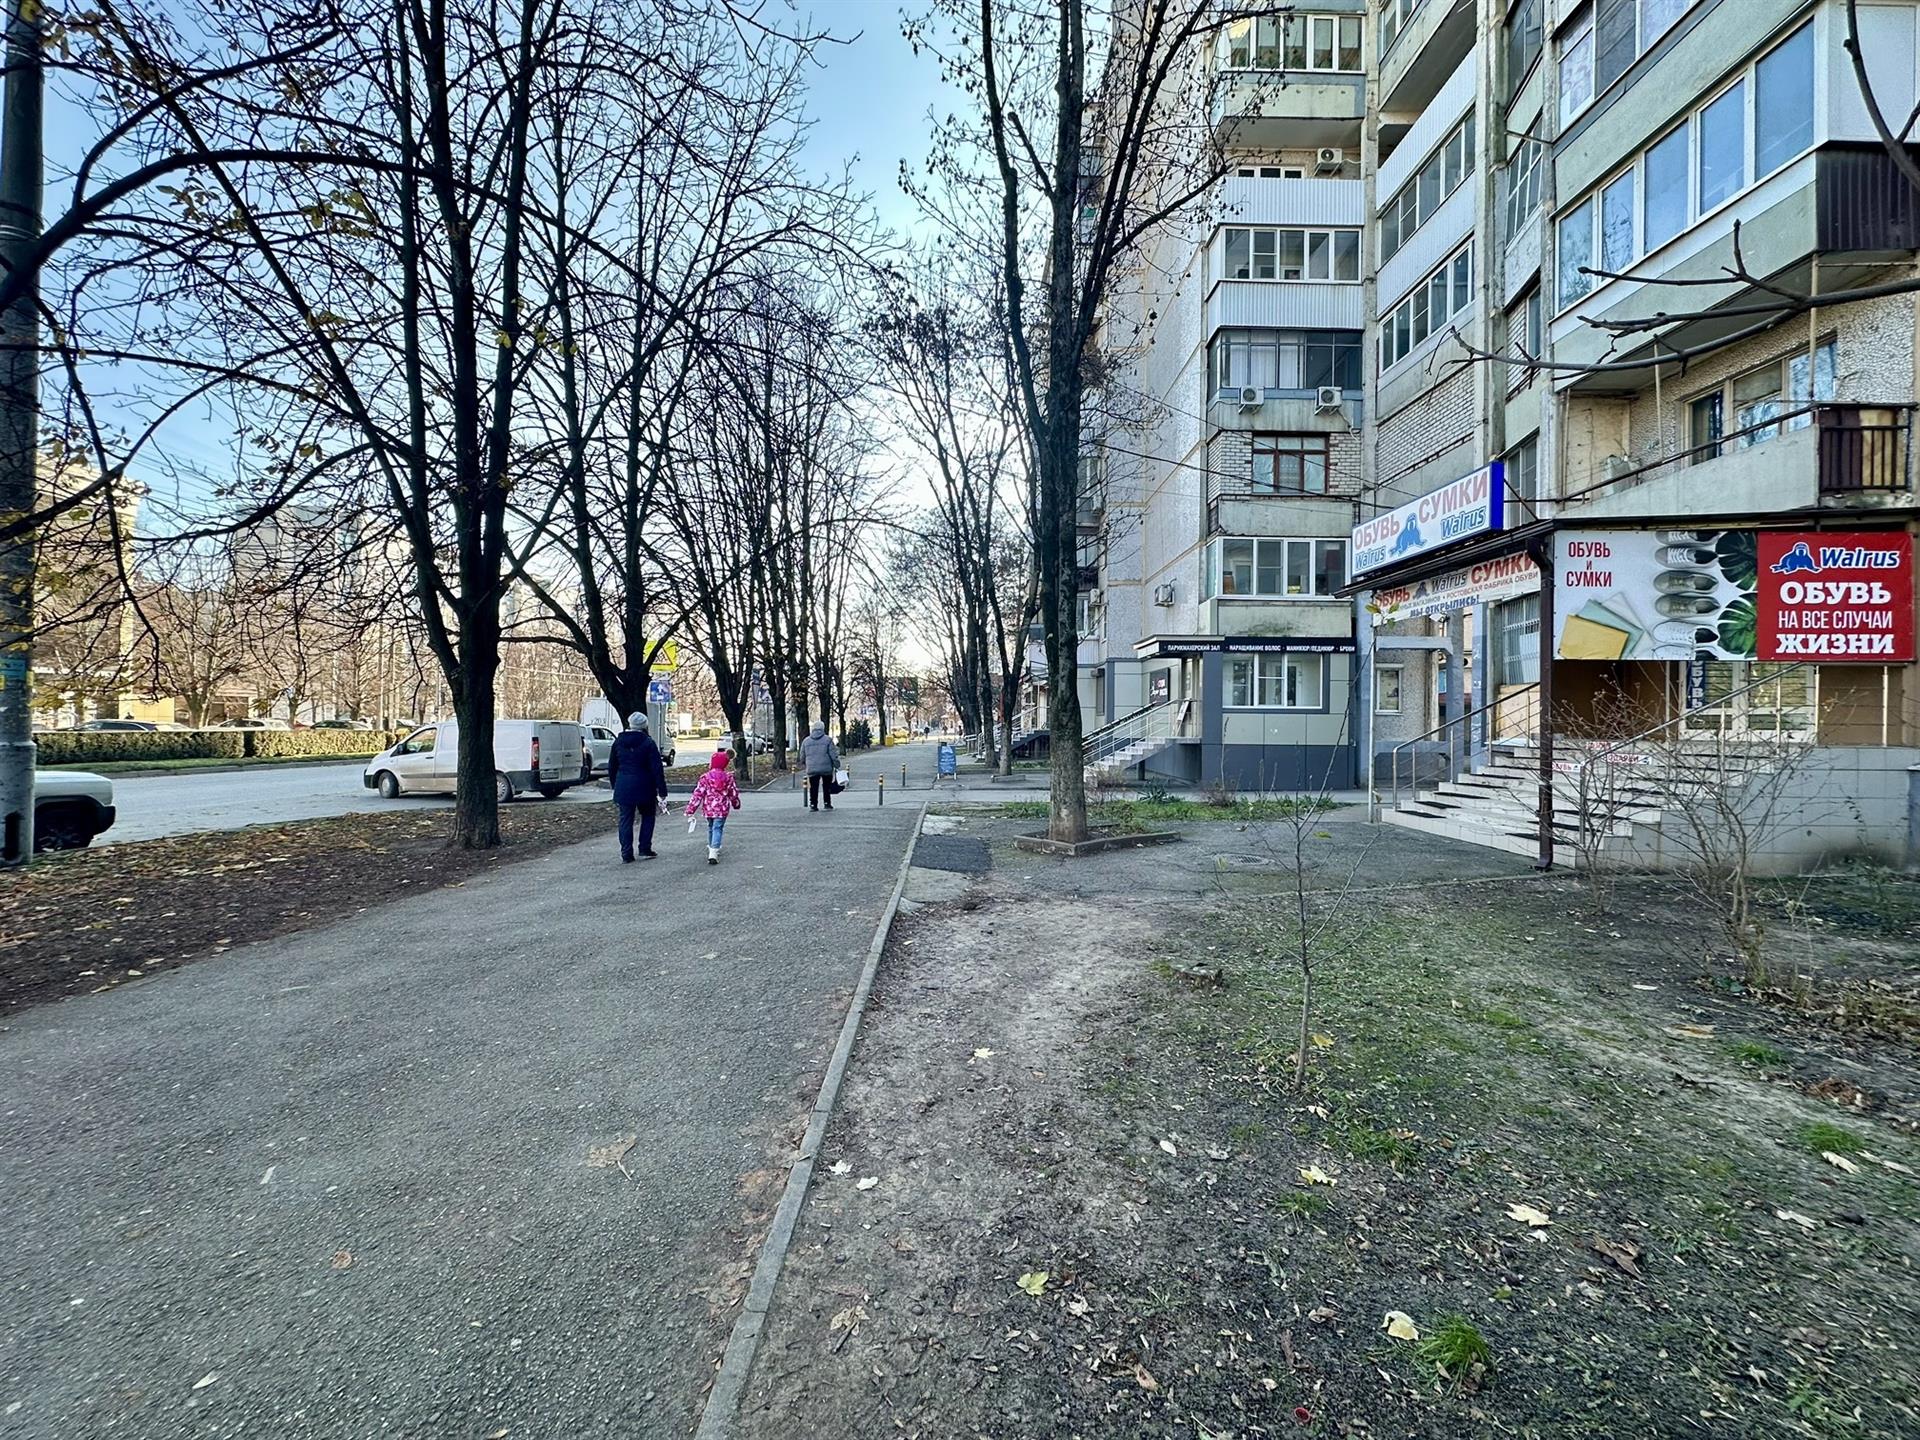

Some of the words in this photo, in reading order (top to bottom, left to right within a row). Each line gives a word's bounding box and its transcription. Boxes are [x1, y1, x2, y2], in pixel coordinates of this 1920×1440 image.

[1355, 514, 1400, 550] ОБУВЬ
[1418, 471, 1488, 524] СУМКИ
[1441, 505, 1487, 540] Walrus
[1355, 545, 1387, 571] Walrus
[1568, 541, 1611, 558] ОБУВЬ
[1820, 546, 1900, 569] Walrus
[1431, 572, 1468, 593] Walrus
[1484, 577, 1514, 590] ФАБРИКА
[1515, 570, 1538, 583] ОБУВИ
[1566, 571, 1612, 588] СУМКИ
[1779, 581, 1892, 605] ОБУВЬ
[1778, 611, 1800, 629] НА
[1802, 611, 1830, 629] ВСЕ
[1832, 610, 1893, 629] СЛУЧАИ
[1776, 632, 1895, 655] ЖИЗНИ
